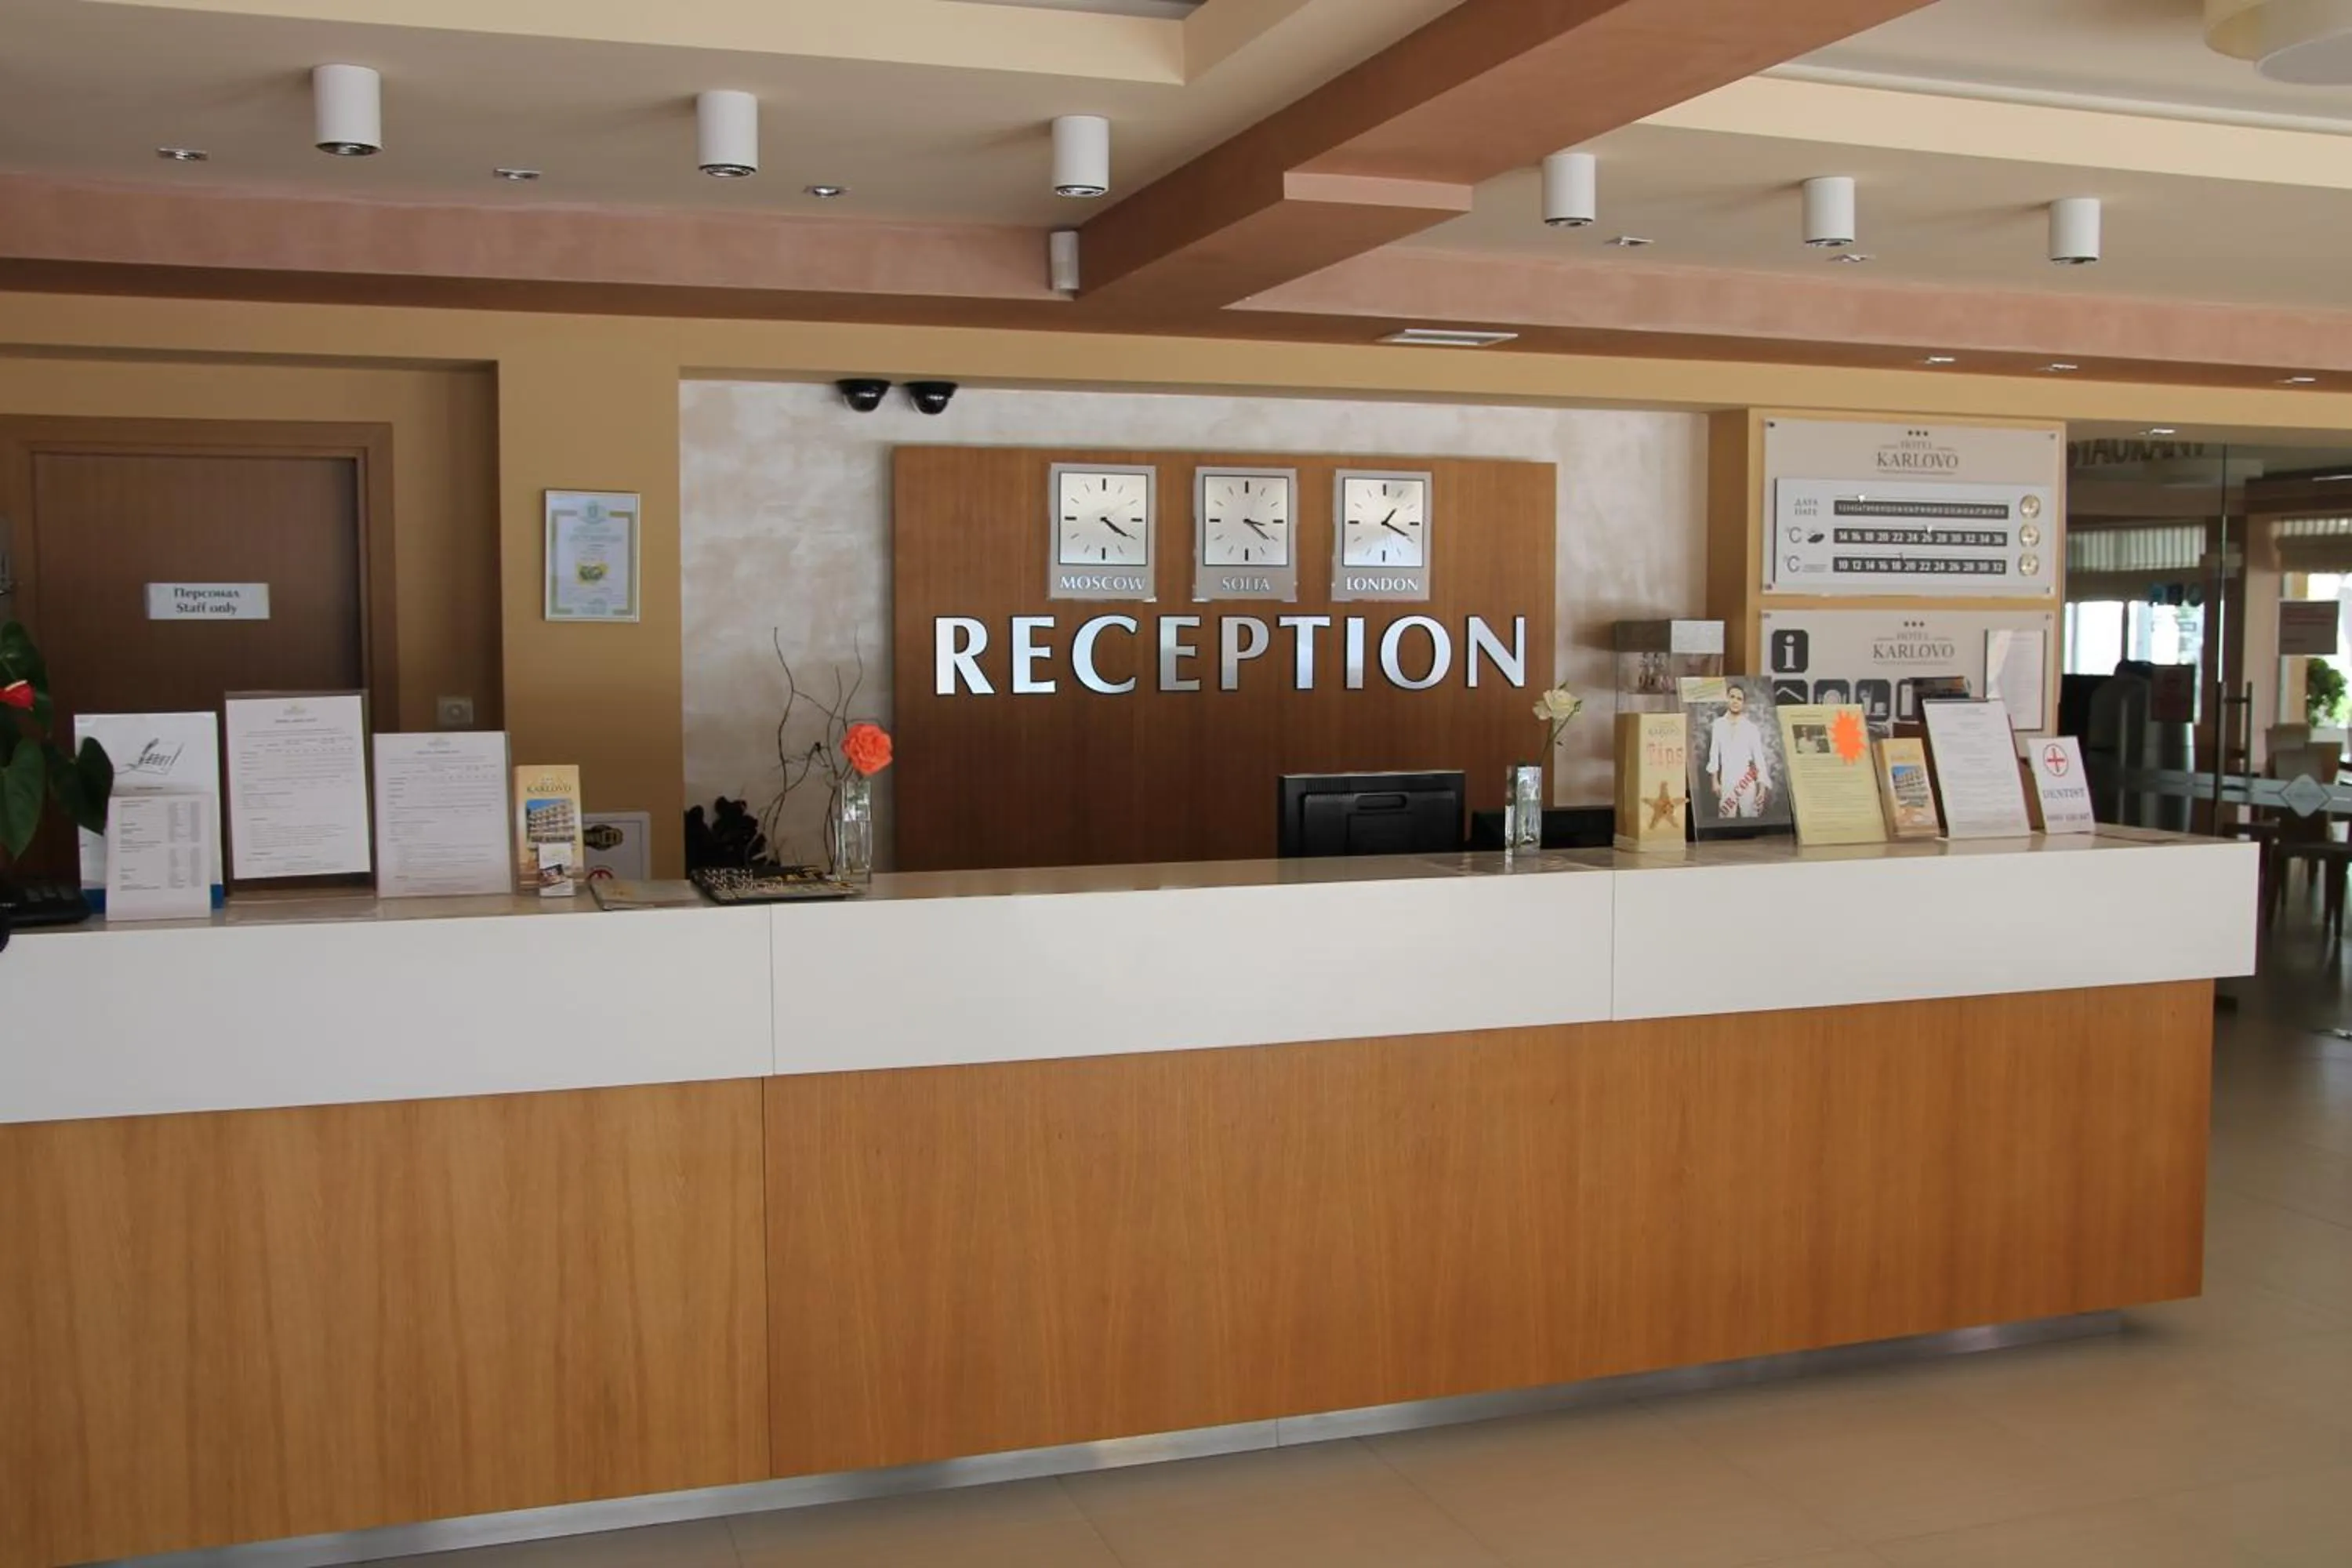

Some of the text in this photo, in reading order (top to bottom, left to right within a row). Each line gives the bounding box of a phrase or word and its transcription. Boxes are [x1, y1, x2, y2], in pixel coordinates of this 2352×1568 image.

[1877, 452, 1958, 468] KARLOVO
[1060, 575, 1145, 592] MOSCOW
[1346, 576, 1419, 592] LONDON
[173, 587, 240, 600] Персонал
[176, 601, 238, 615] Staff only
[1896, 632, 1929, 641] HOTEL
[935, 615, 1526, 695] RECEPTION
[1873, 643, 1955, 659] KARLOVO
